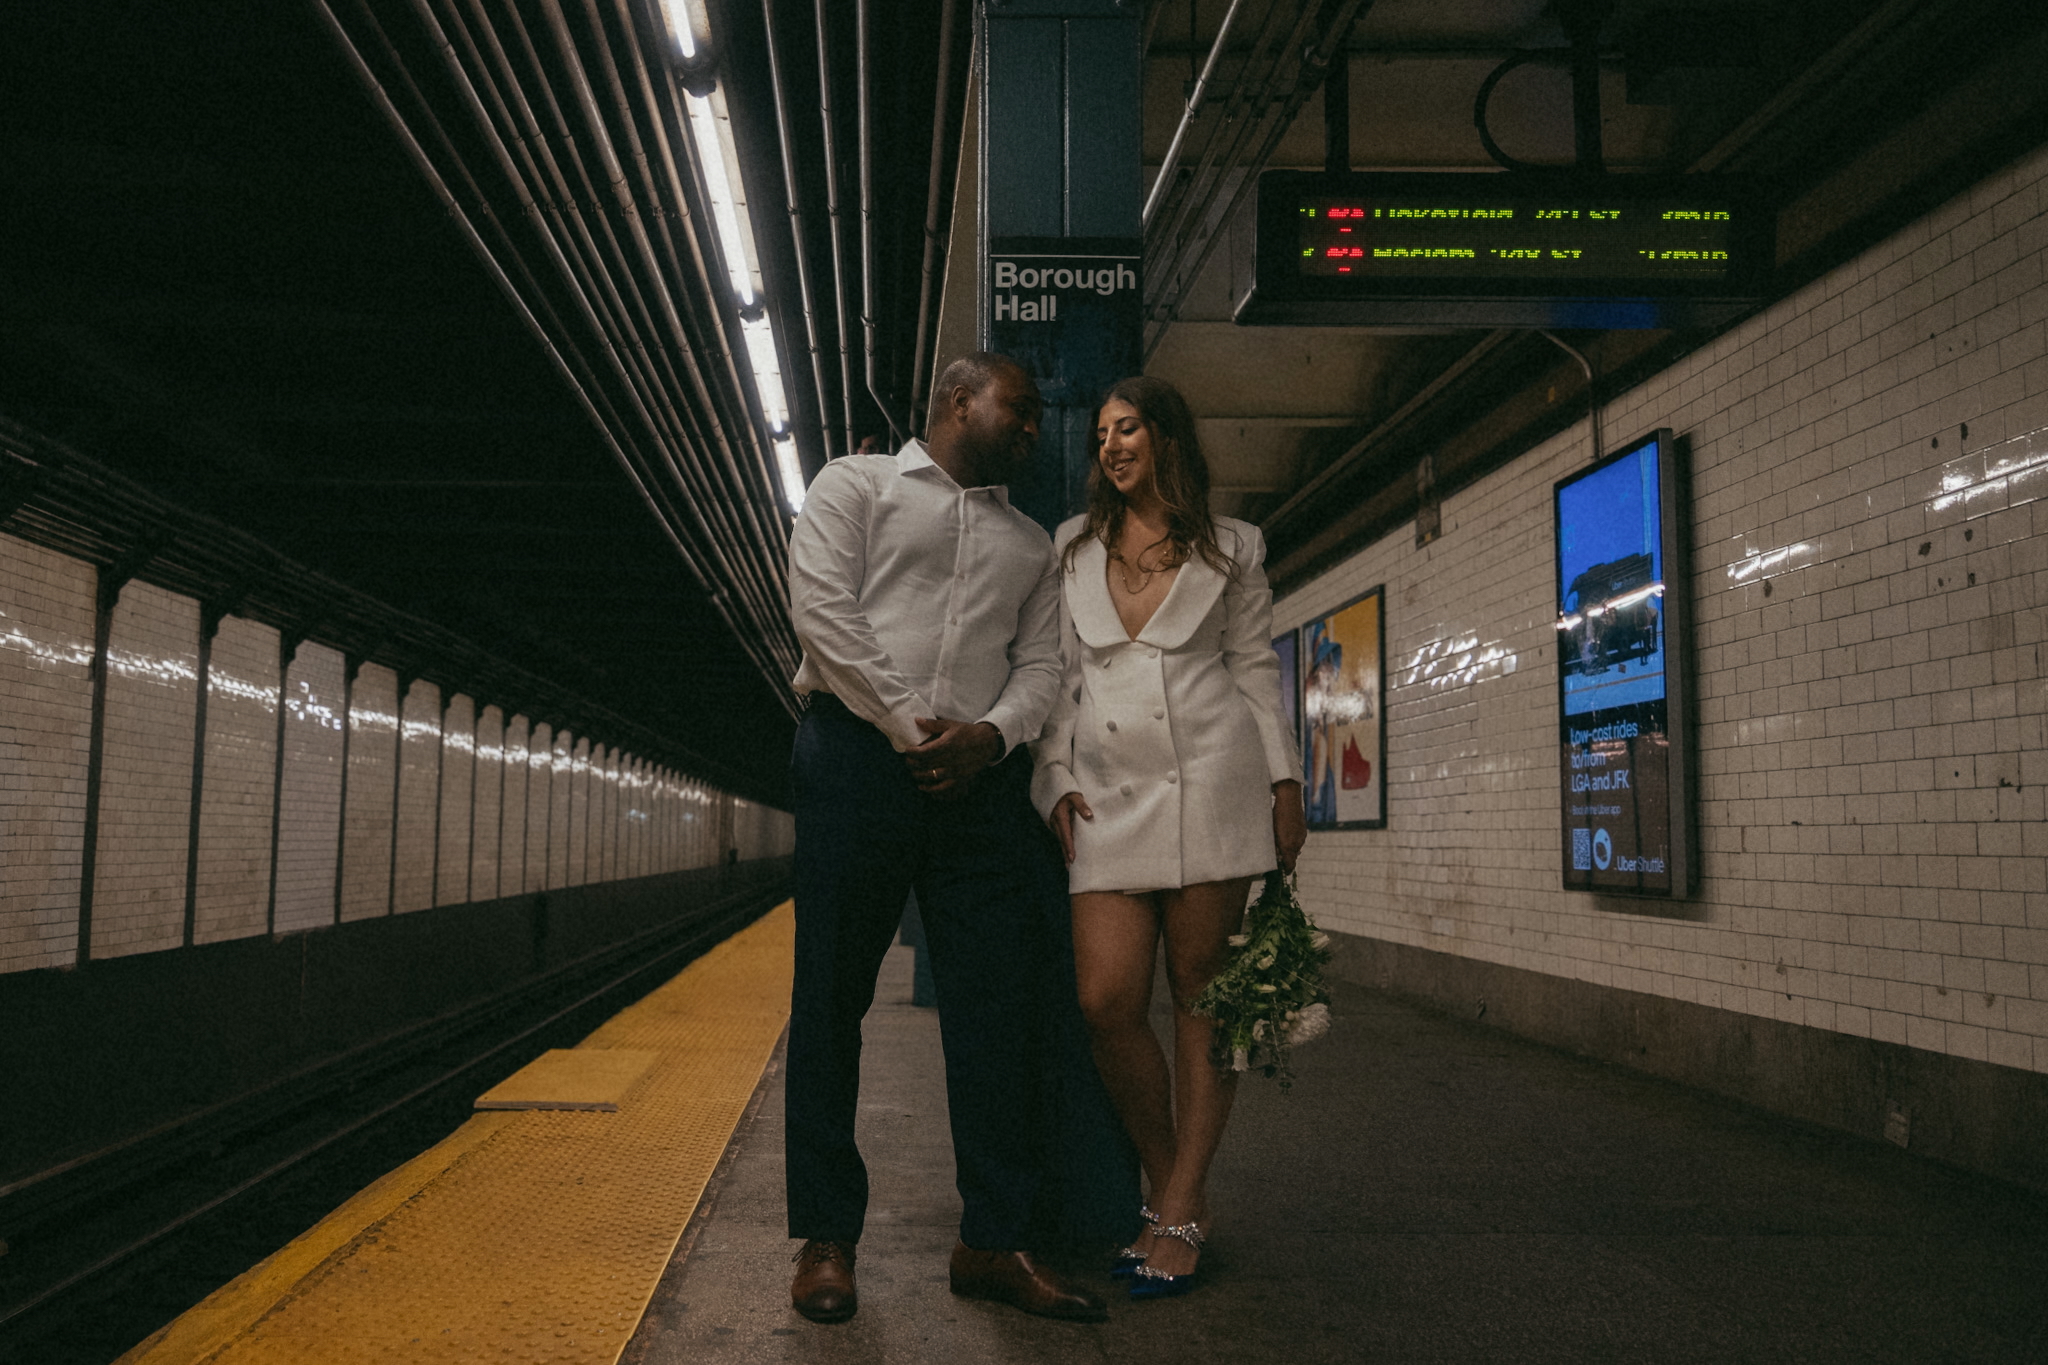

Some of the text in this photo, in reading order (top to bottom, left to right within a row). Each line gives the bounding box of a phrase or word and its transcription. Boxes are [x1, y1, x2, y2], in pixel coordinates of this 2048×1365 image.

[995, 261, 1137, 296] Borough
[995, 294, 1057, 321] Hall
[1570, 719, 1638, 745] Low-cost rides
[1571, 749, 1606, 769] to/from
[1571, 768, 1630, 793] LGA and JFK
[1616, 855, 1664, 873] Uber Shuttle
